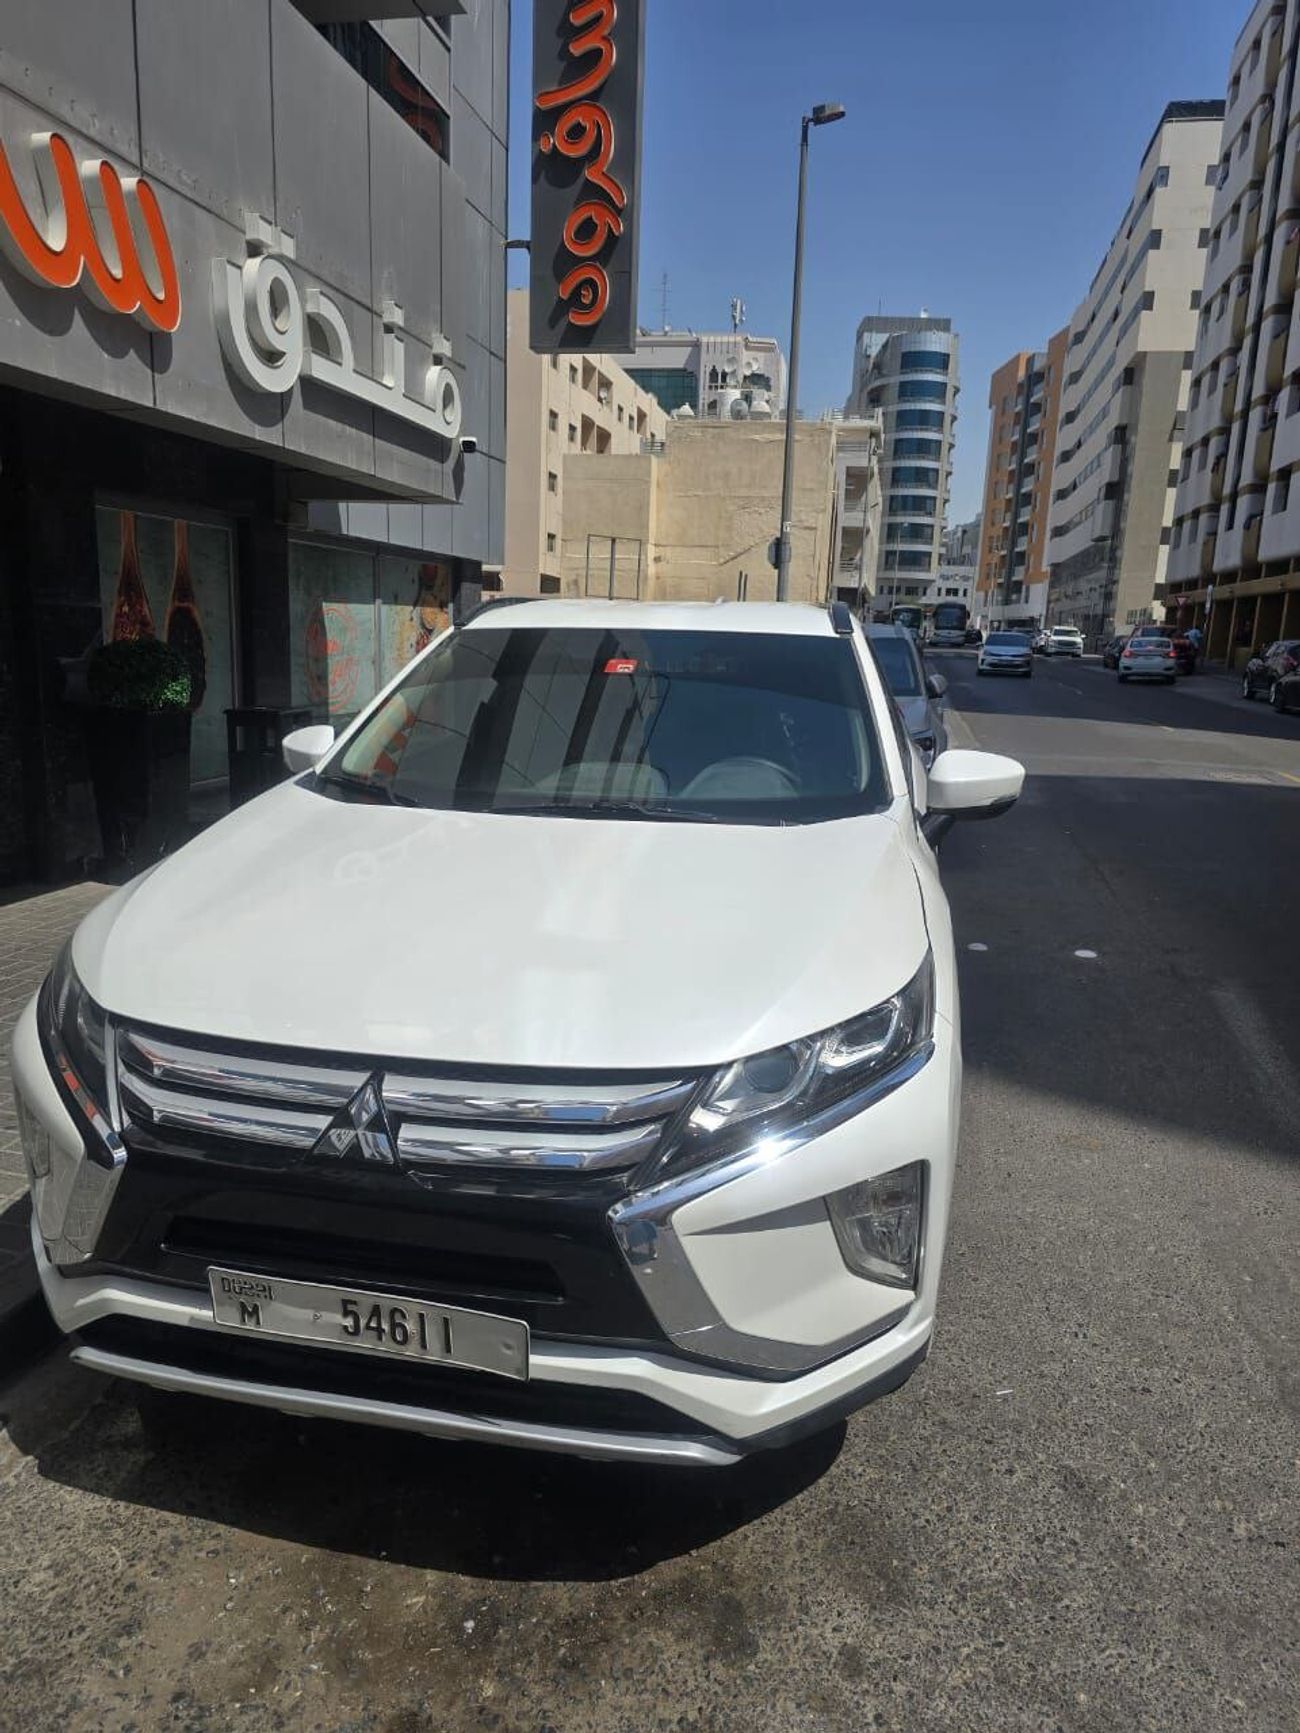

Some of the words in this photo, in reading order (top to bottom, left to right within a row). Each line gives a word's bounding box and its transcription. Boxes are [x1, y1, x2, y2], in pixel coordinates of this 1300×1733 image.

[212, 212, 462, 439] فندق
[239, 1300, 262, 1326] M
[341, 1298, 453, 1354] 54611
